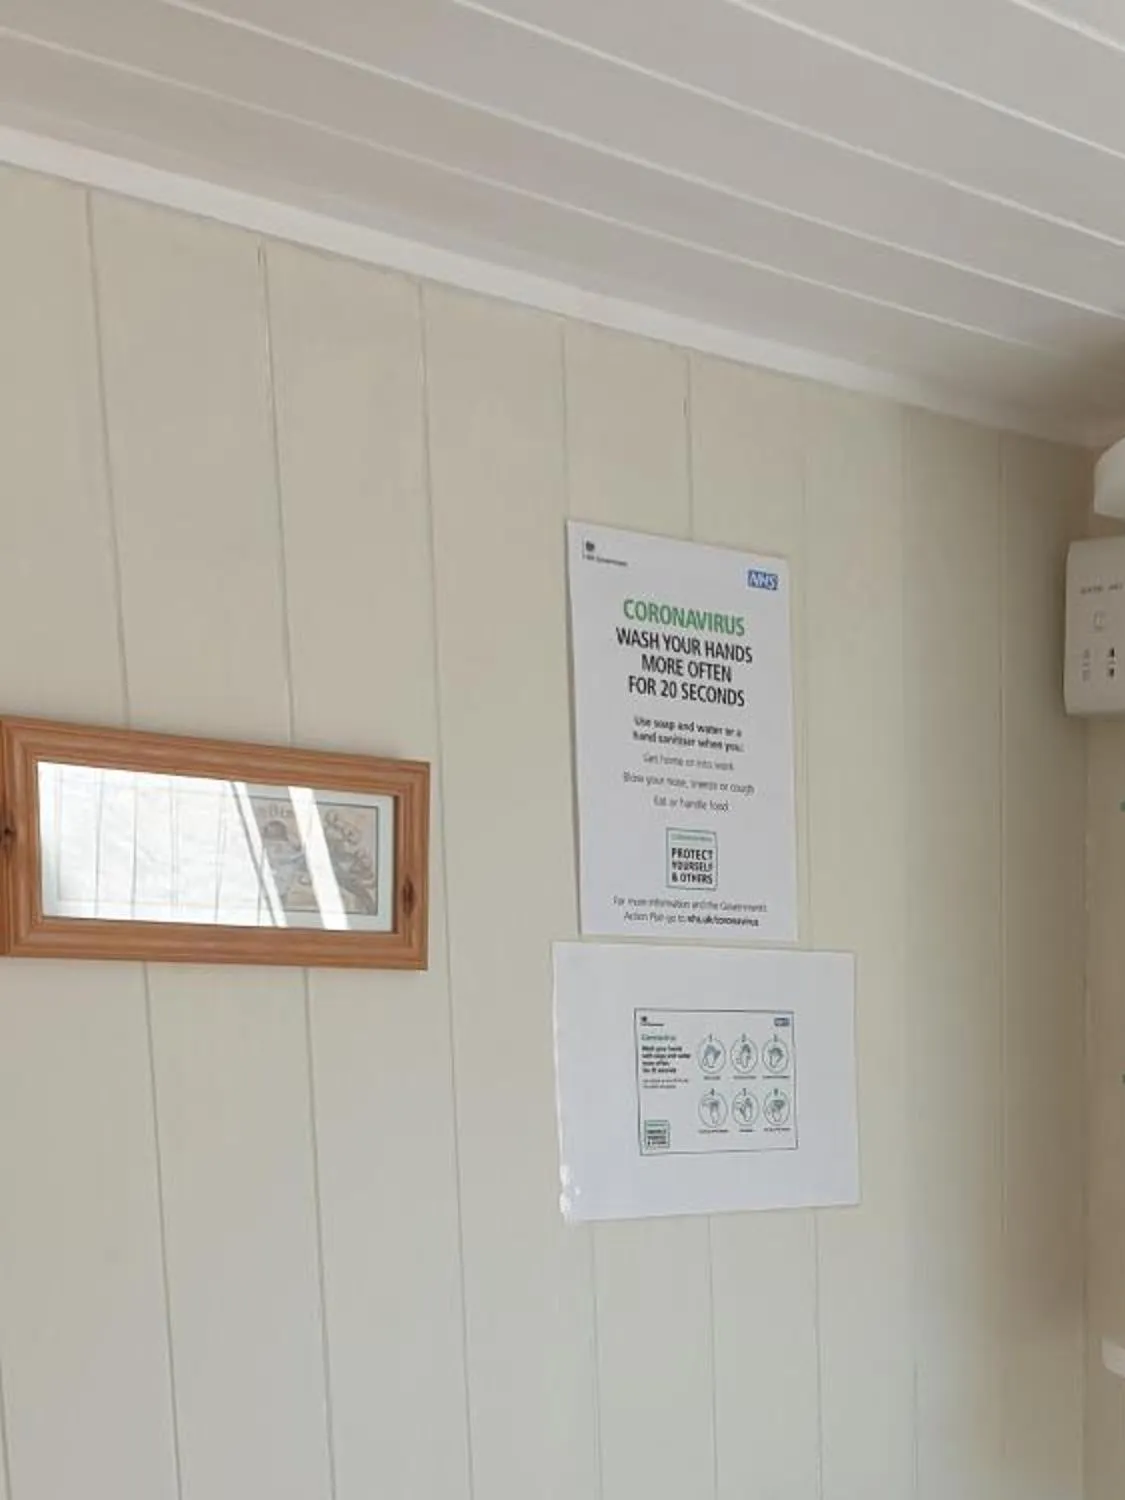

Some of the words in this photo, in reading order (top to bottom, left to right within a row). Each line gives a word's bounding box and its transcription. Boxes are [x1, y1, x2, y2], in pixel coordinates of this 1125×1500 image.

[749, 570, 778, 590] NHS
[623, 599, 745, 636] CORONAVIRUS
[616, 627, 659, 650] WASH
[662, 634, 700, 656] YOUR
[705, 641, 753, 663] HANDS
[641, 654, 683, 677] MORE
[687, 662, 731, 682] OFTEN
[628, 675, 656, 696] FOR
[660, 680, 677, 698] 20
[682, 684, 745, 707] SECONDS
[633, 716, 651, 728] Use
[653, 719, 675, 731] soap
[678, 721, 694, 732] and
[696, 725, 722, 735] water
[633, 731, 656, 743] hand
[698, 738, 722, 749] when
[730, 783, 755, 797] cough
[671, 847, 713, 861] PROTECT
[671, 861, 713, 873] YOURSELF
[680, 872, 713, 885] OTHERS
